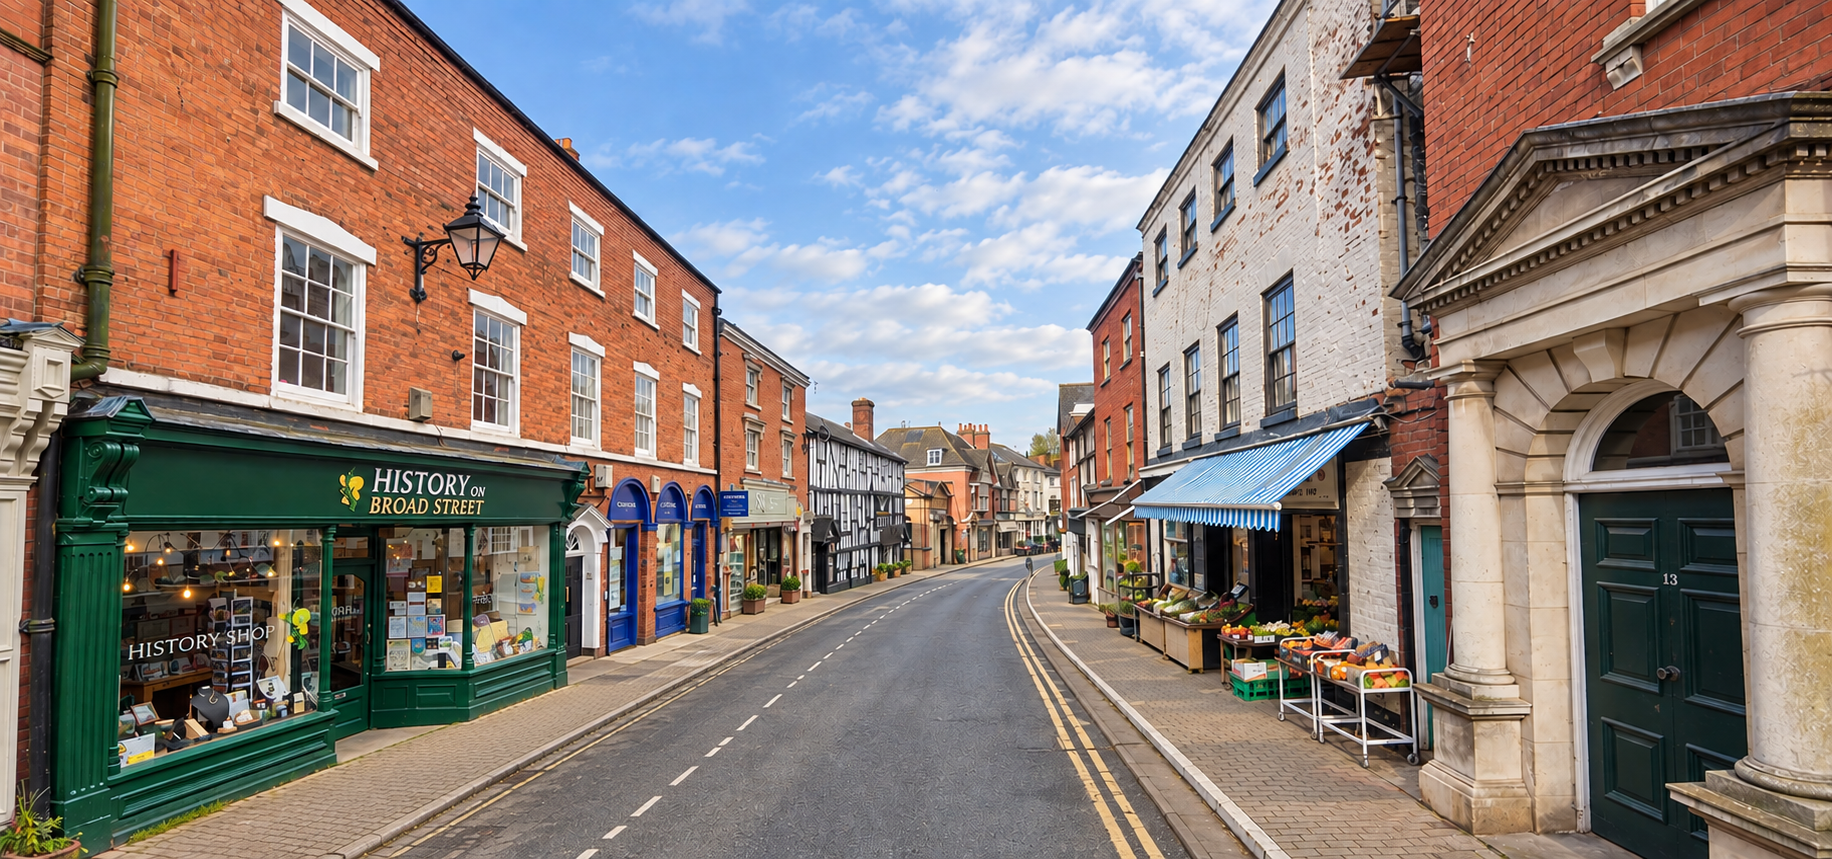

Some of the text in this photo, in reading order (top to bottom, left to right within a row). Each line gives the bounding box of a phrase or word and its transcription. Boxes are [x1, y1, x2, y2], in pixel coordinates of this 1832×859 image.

[371, 467, 486, 497] HISTORY ON
[368, 496, 485, 516] BROAD STREET
[1662, 572, 1678, 586] 13
[127, 625, 276, 661] HISTORY SHOP
